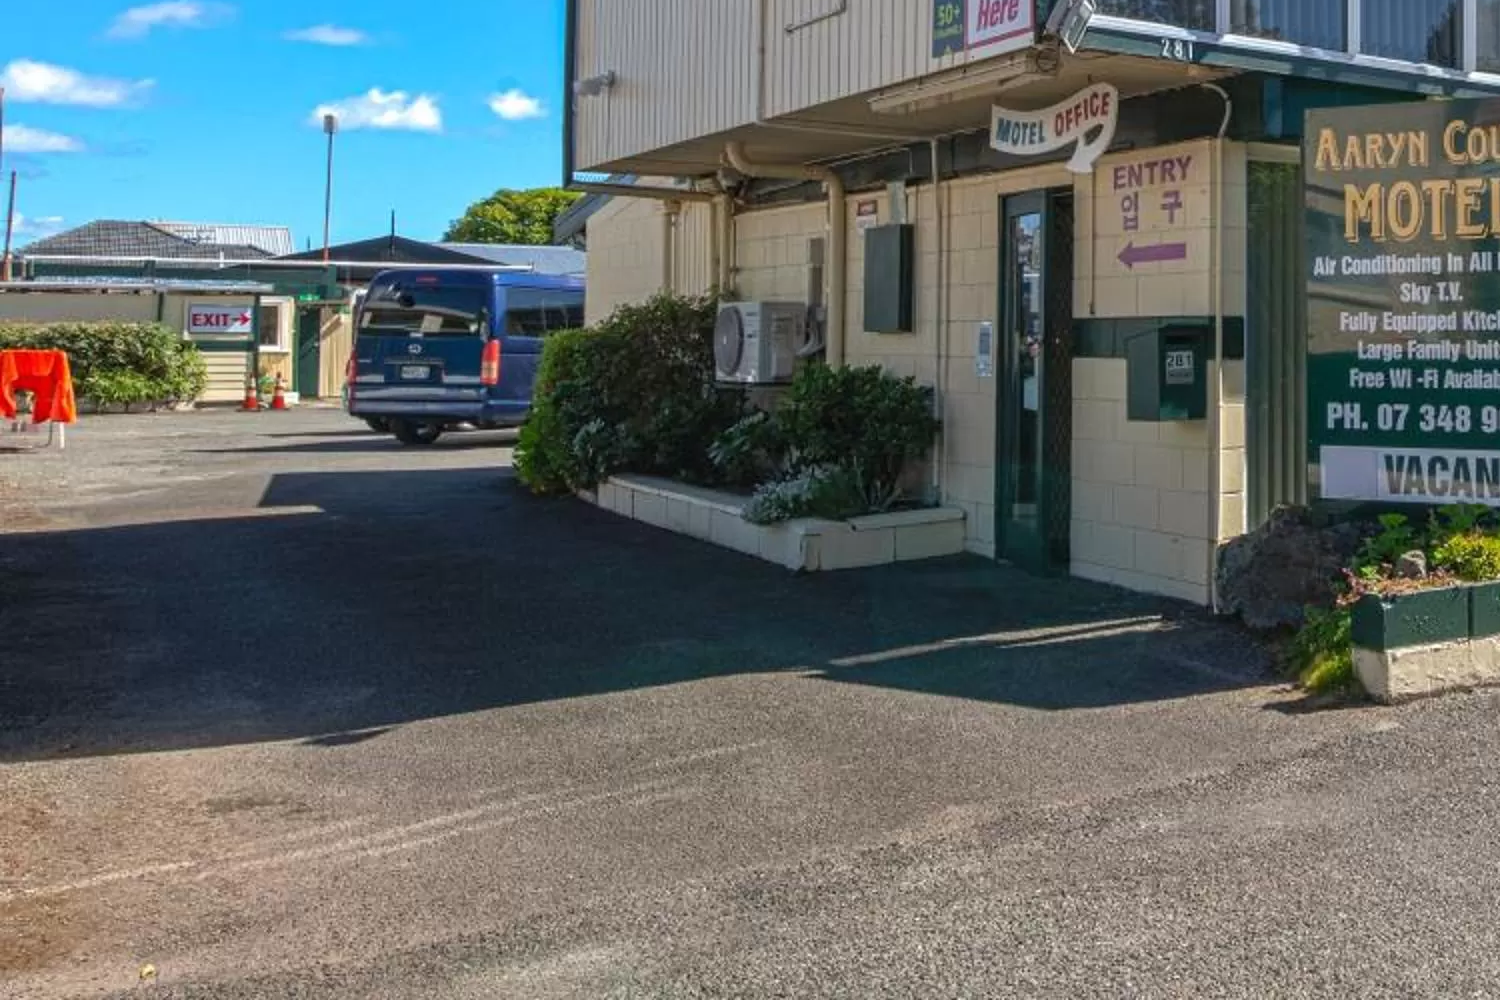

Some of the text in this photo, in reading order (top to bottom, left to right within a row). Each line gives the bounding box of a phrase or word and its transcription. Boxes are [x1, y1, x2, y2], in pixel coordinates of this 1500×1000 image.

[1161, 39, 1193, 61] 281
[995, 92, 1111, 145] MOTEL OFFICE
[1315, 128, 1429, 171] AARYN
[1113, 156, 1193, 190] ENTRY
[1314, 257, 1335, 276] Air
[1341, 254, 1441, 275] Conditioning
[1470, 252, 1492, 272] All
[1400, 282, 1464, 304] Sky T.V.
[192, 314, 230, 327] EXIT
[1340, 312, 1377, 333] Fully
[1383, 312, 1457, 333] Equipped
[1358, 341, 1402, 362] Large
[1407, 340, 1460, 363] Family
[1350, 369, 1385, 388] Free
[1327, 402, 1368, 430] PH.
[1377, 403, 1410, 431] 07
[1419, 404, 1471, 433] 348
